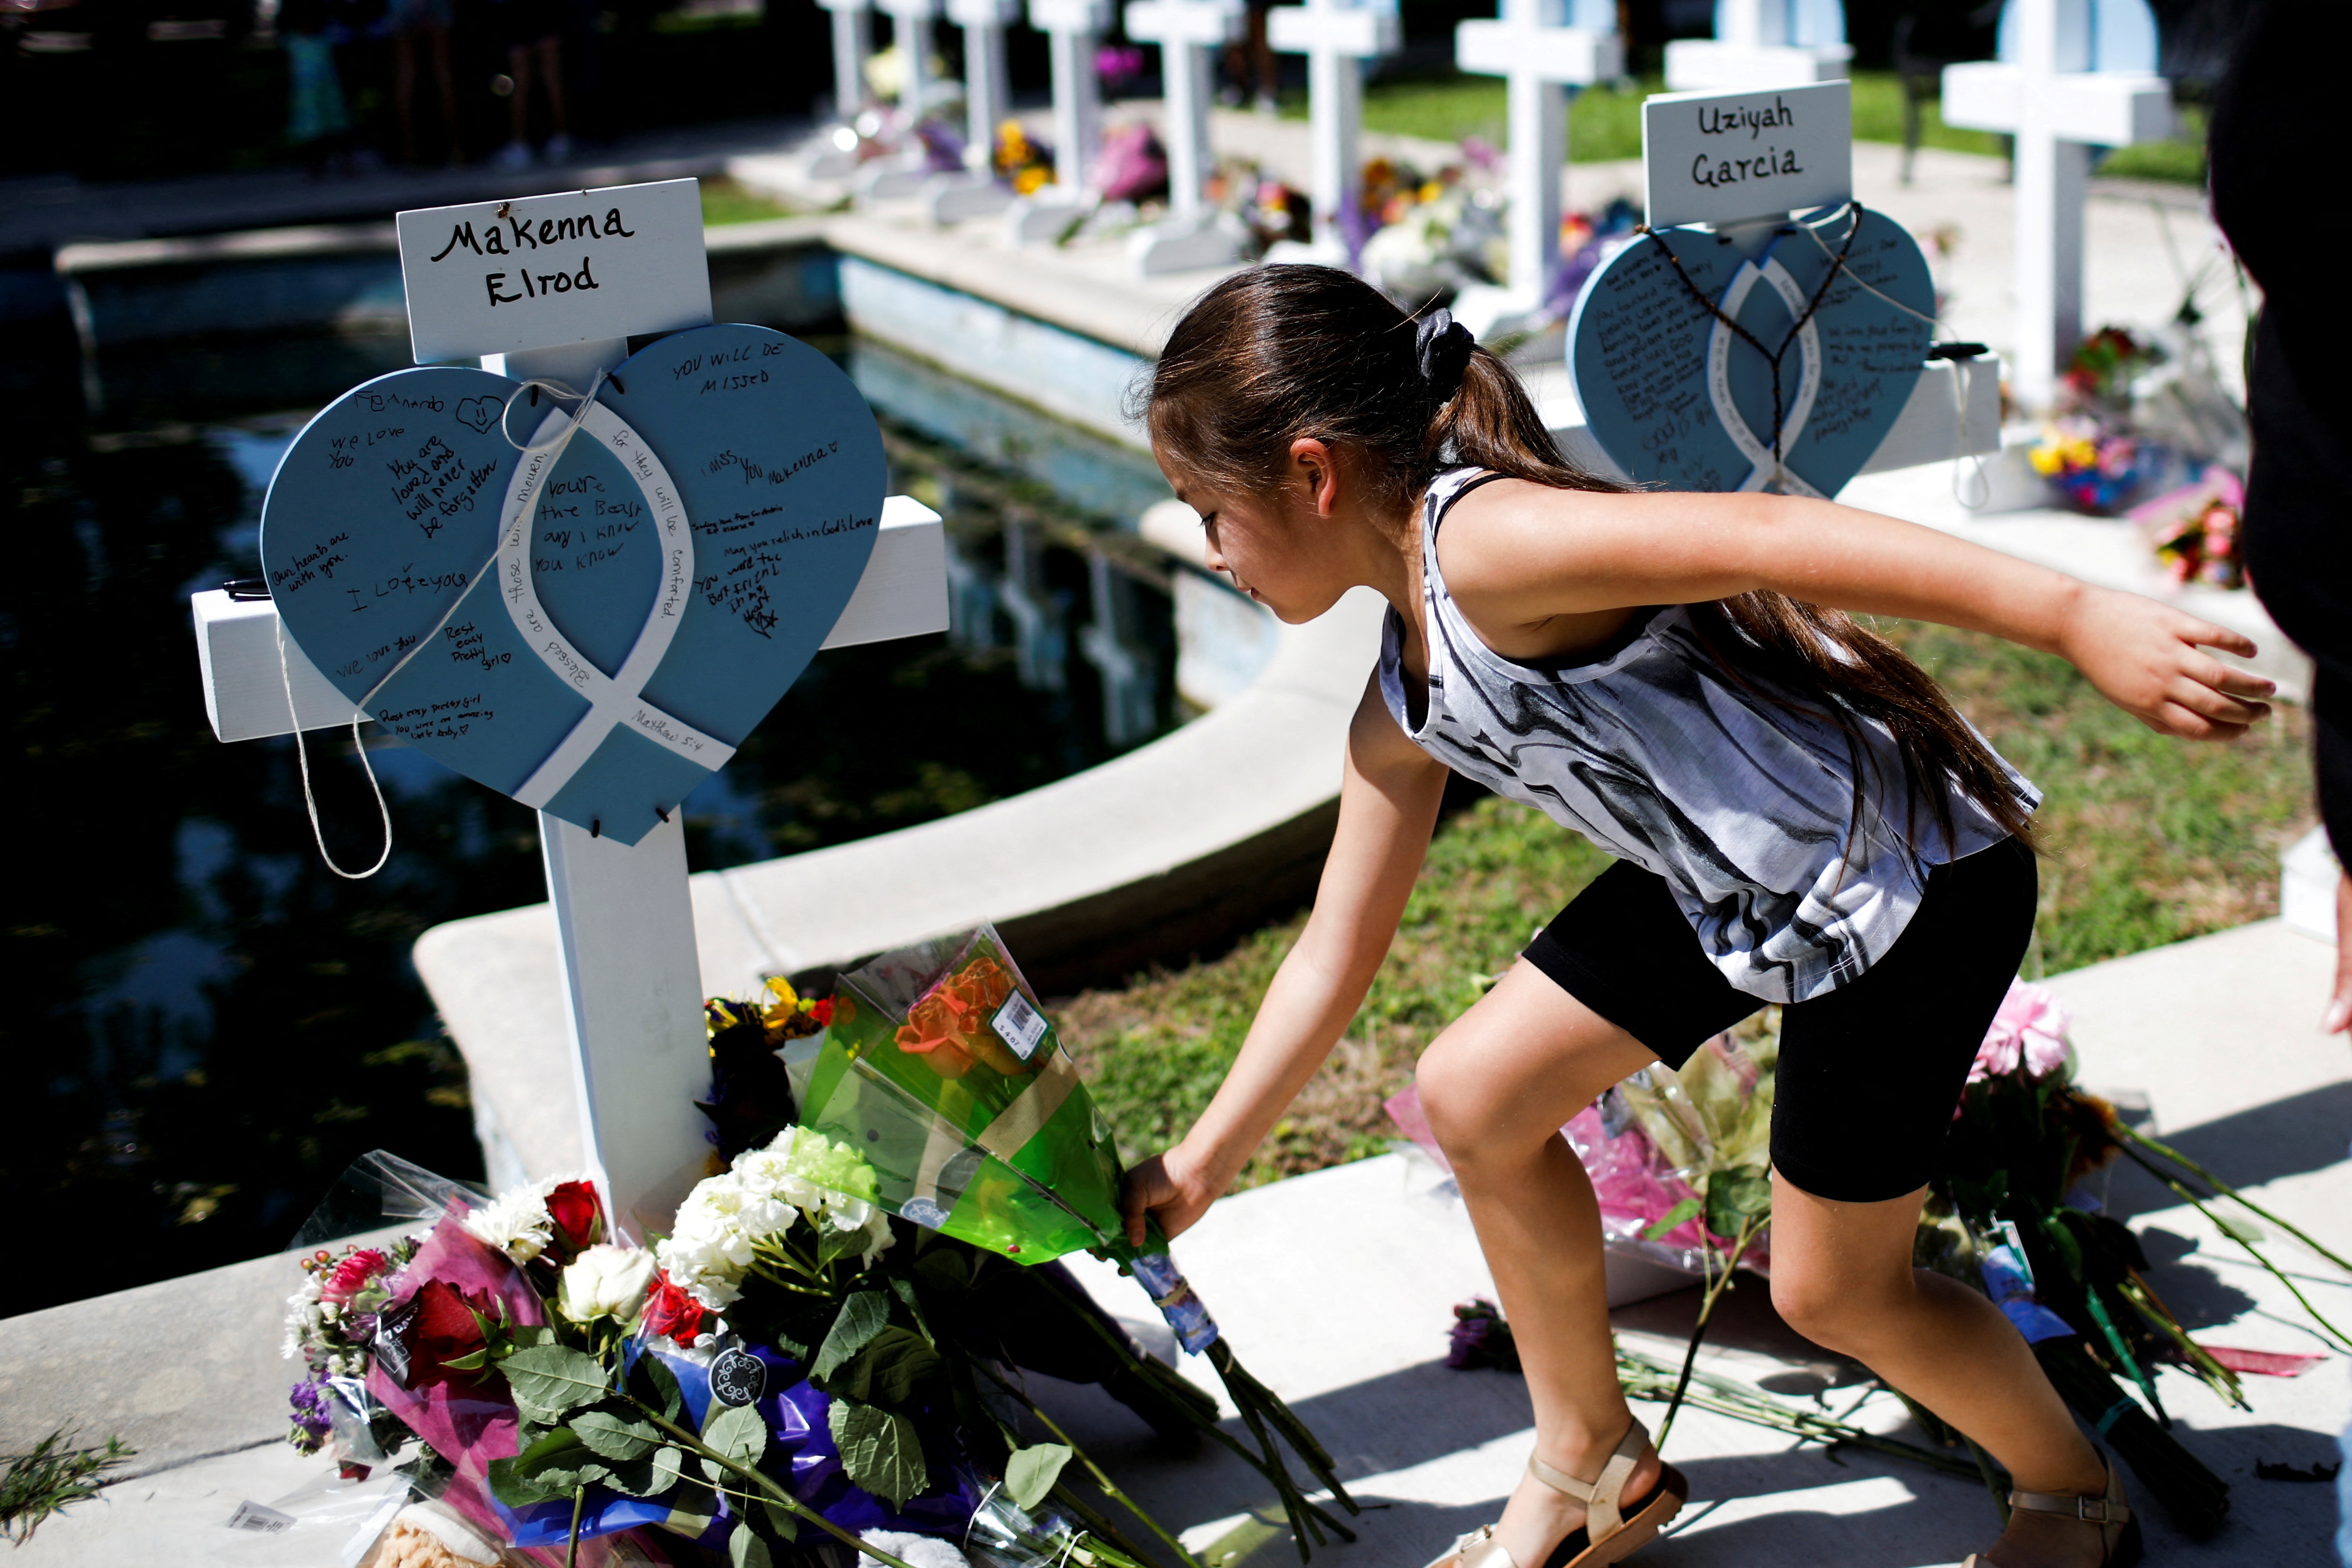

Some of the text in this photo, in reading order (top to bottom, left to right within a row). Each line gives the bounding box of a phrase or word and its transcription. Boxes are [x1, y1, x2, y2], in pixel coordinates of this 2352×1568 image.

[1698, 95, 1794, 140] Uziyah
[1692, 146, 1804, 188] Garcia
[431, 208, 635, 262] Makenna
[485, 256, 599, 307] Elrod
[674, 354, 702, 380] YOU
[711, 345, 751, 366] WILL
[701, 369, 769, 395] MISSED
[419, 436, 442, 458] are
[391, 443, 454, 505] loved and
[407, 458, 465, 520] will never
[420, 458, 498, 539] be forgotten
[632, 449, 654, 481] they
[655, 486, 674, 512] will
[666, 514, 679, 537] be
[540, 505, 580, 520] the
[771, 528, 805, 545] relish
[807, 529, 820, 538] in
[821, 518, 847, 537] God's
[291, 543, 329, 572] hearts
[330, 532, 350, 546] are
[288, 570, 316, 592] with
[508, 558, 525, 604] those
[346, 588, 368, 612] I
[444, 621, 476, 642] Rest
[526, 608, 544, 633] are
[456, 633, 483, 648] easy
[366, 645, 391, 664] love
[481, 655, 499, 671] girl
[544, 641, 590, 688] Blessed
[406, 707, 427, 718] easy
[462, 693, 481, 708] girl
[415, 720, 434, 730] were
[458, 710, 494, 720] amazing
[631, 709, 679, 741] Matthew
[383, 1329, 393, 1340] 7
